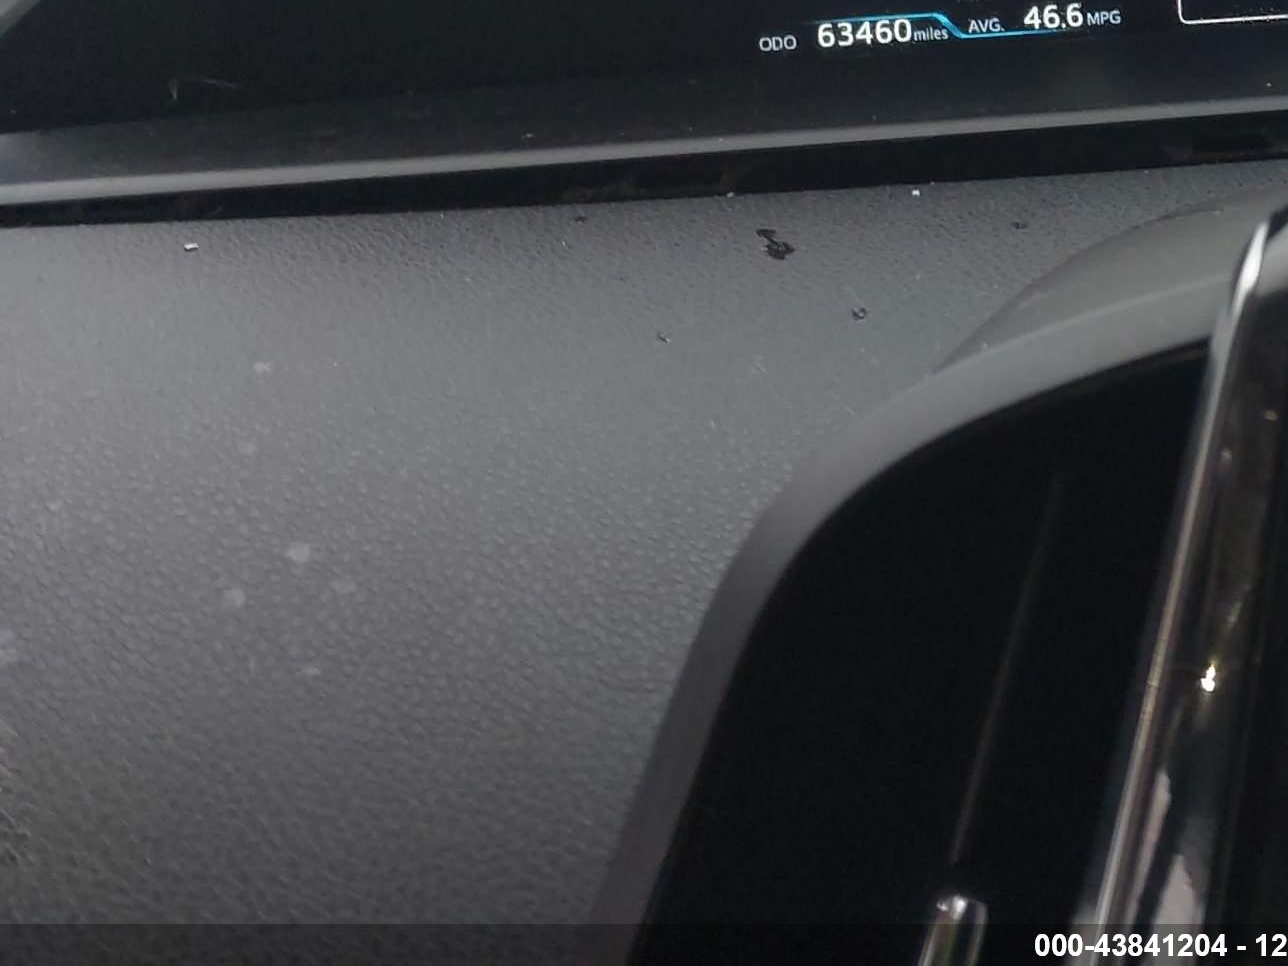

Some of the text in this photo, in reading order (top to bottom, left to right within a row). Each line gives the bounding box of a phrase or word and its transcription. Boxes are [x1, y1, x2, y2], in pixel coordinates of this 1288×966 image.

[968, 2, 1122, 34] AVG. 46.6 MPG
[759, 18, 950, 52] ODO 63460 miles
